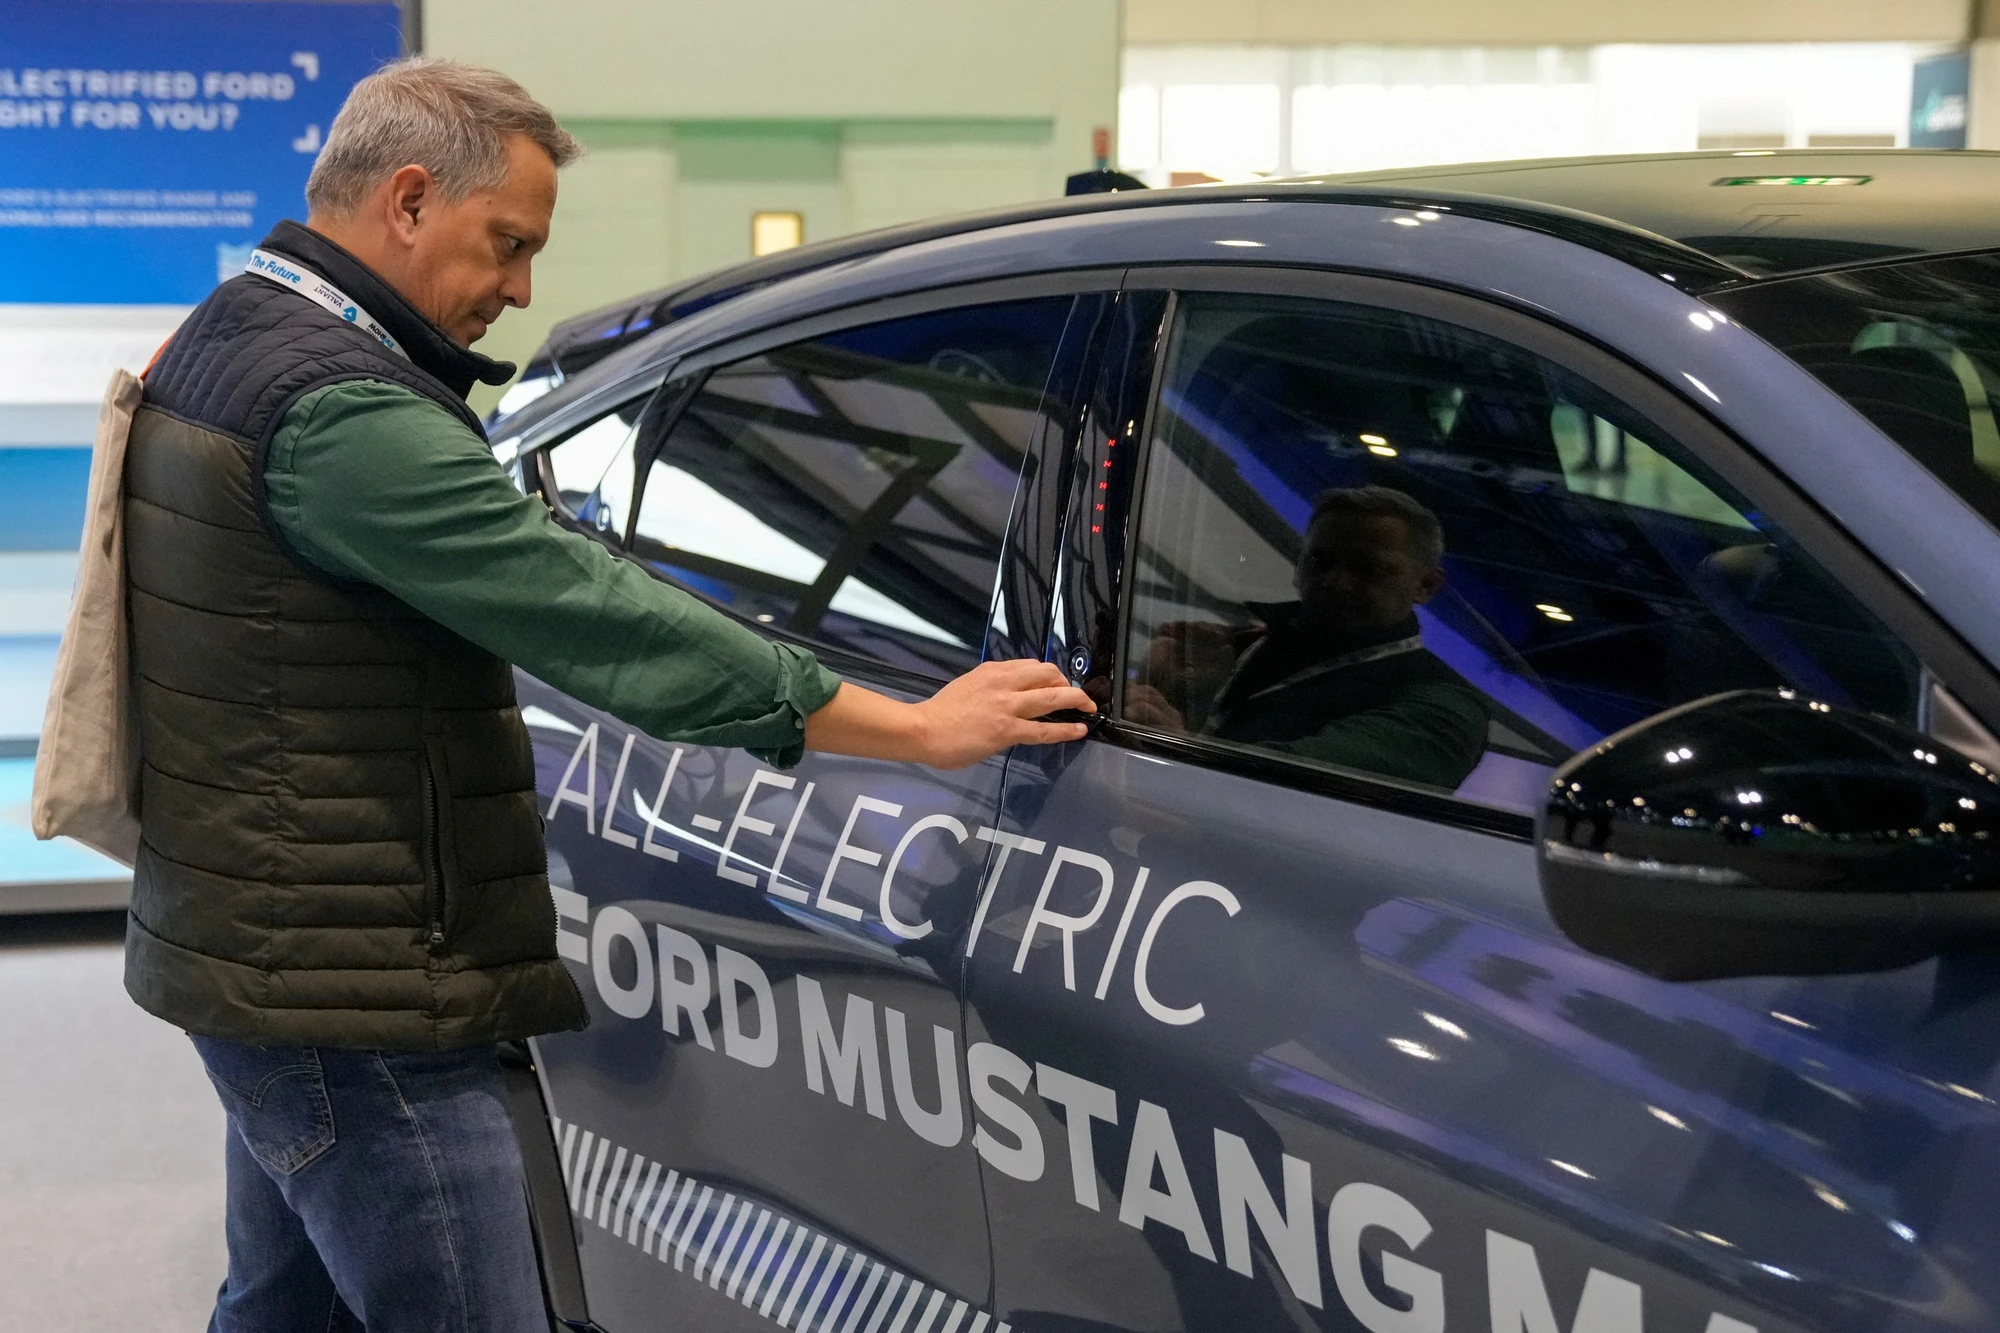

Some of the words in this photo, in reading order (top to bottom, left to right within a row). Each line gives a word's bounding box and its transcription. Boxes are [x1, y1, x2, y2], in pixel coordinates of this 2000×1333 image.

[203, 71, 294, 101] FORD
[71, 101, 141, 130] FOR
[147, 101, 239, 131] YOU?
[251, 255, 265, 269] The
[265, 261, 301, 284] Future
[314, 286, 342, 308] VALIANT
[547, 722, 1242, 1026] ALL-ELECTRIC
[796, 974, 1446, 1333] MUSTANG
